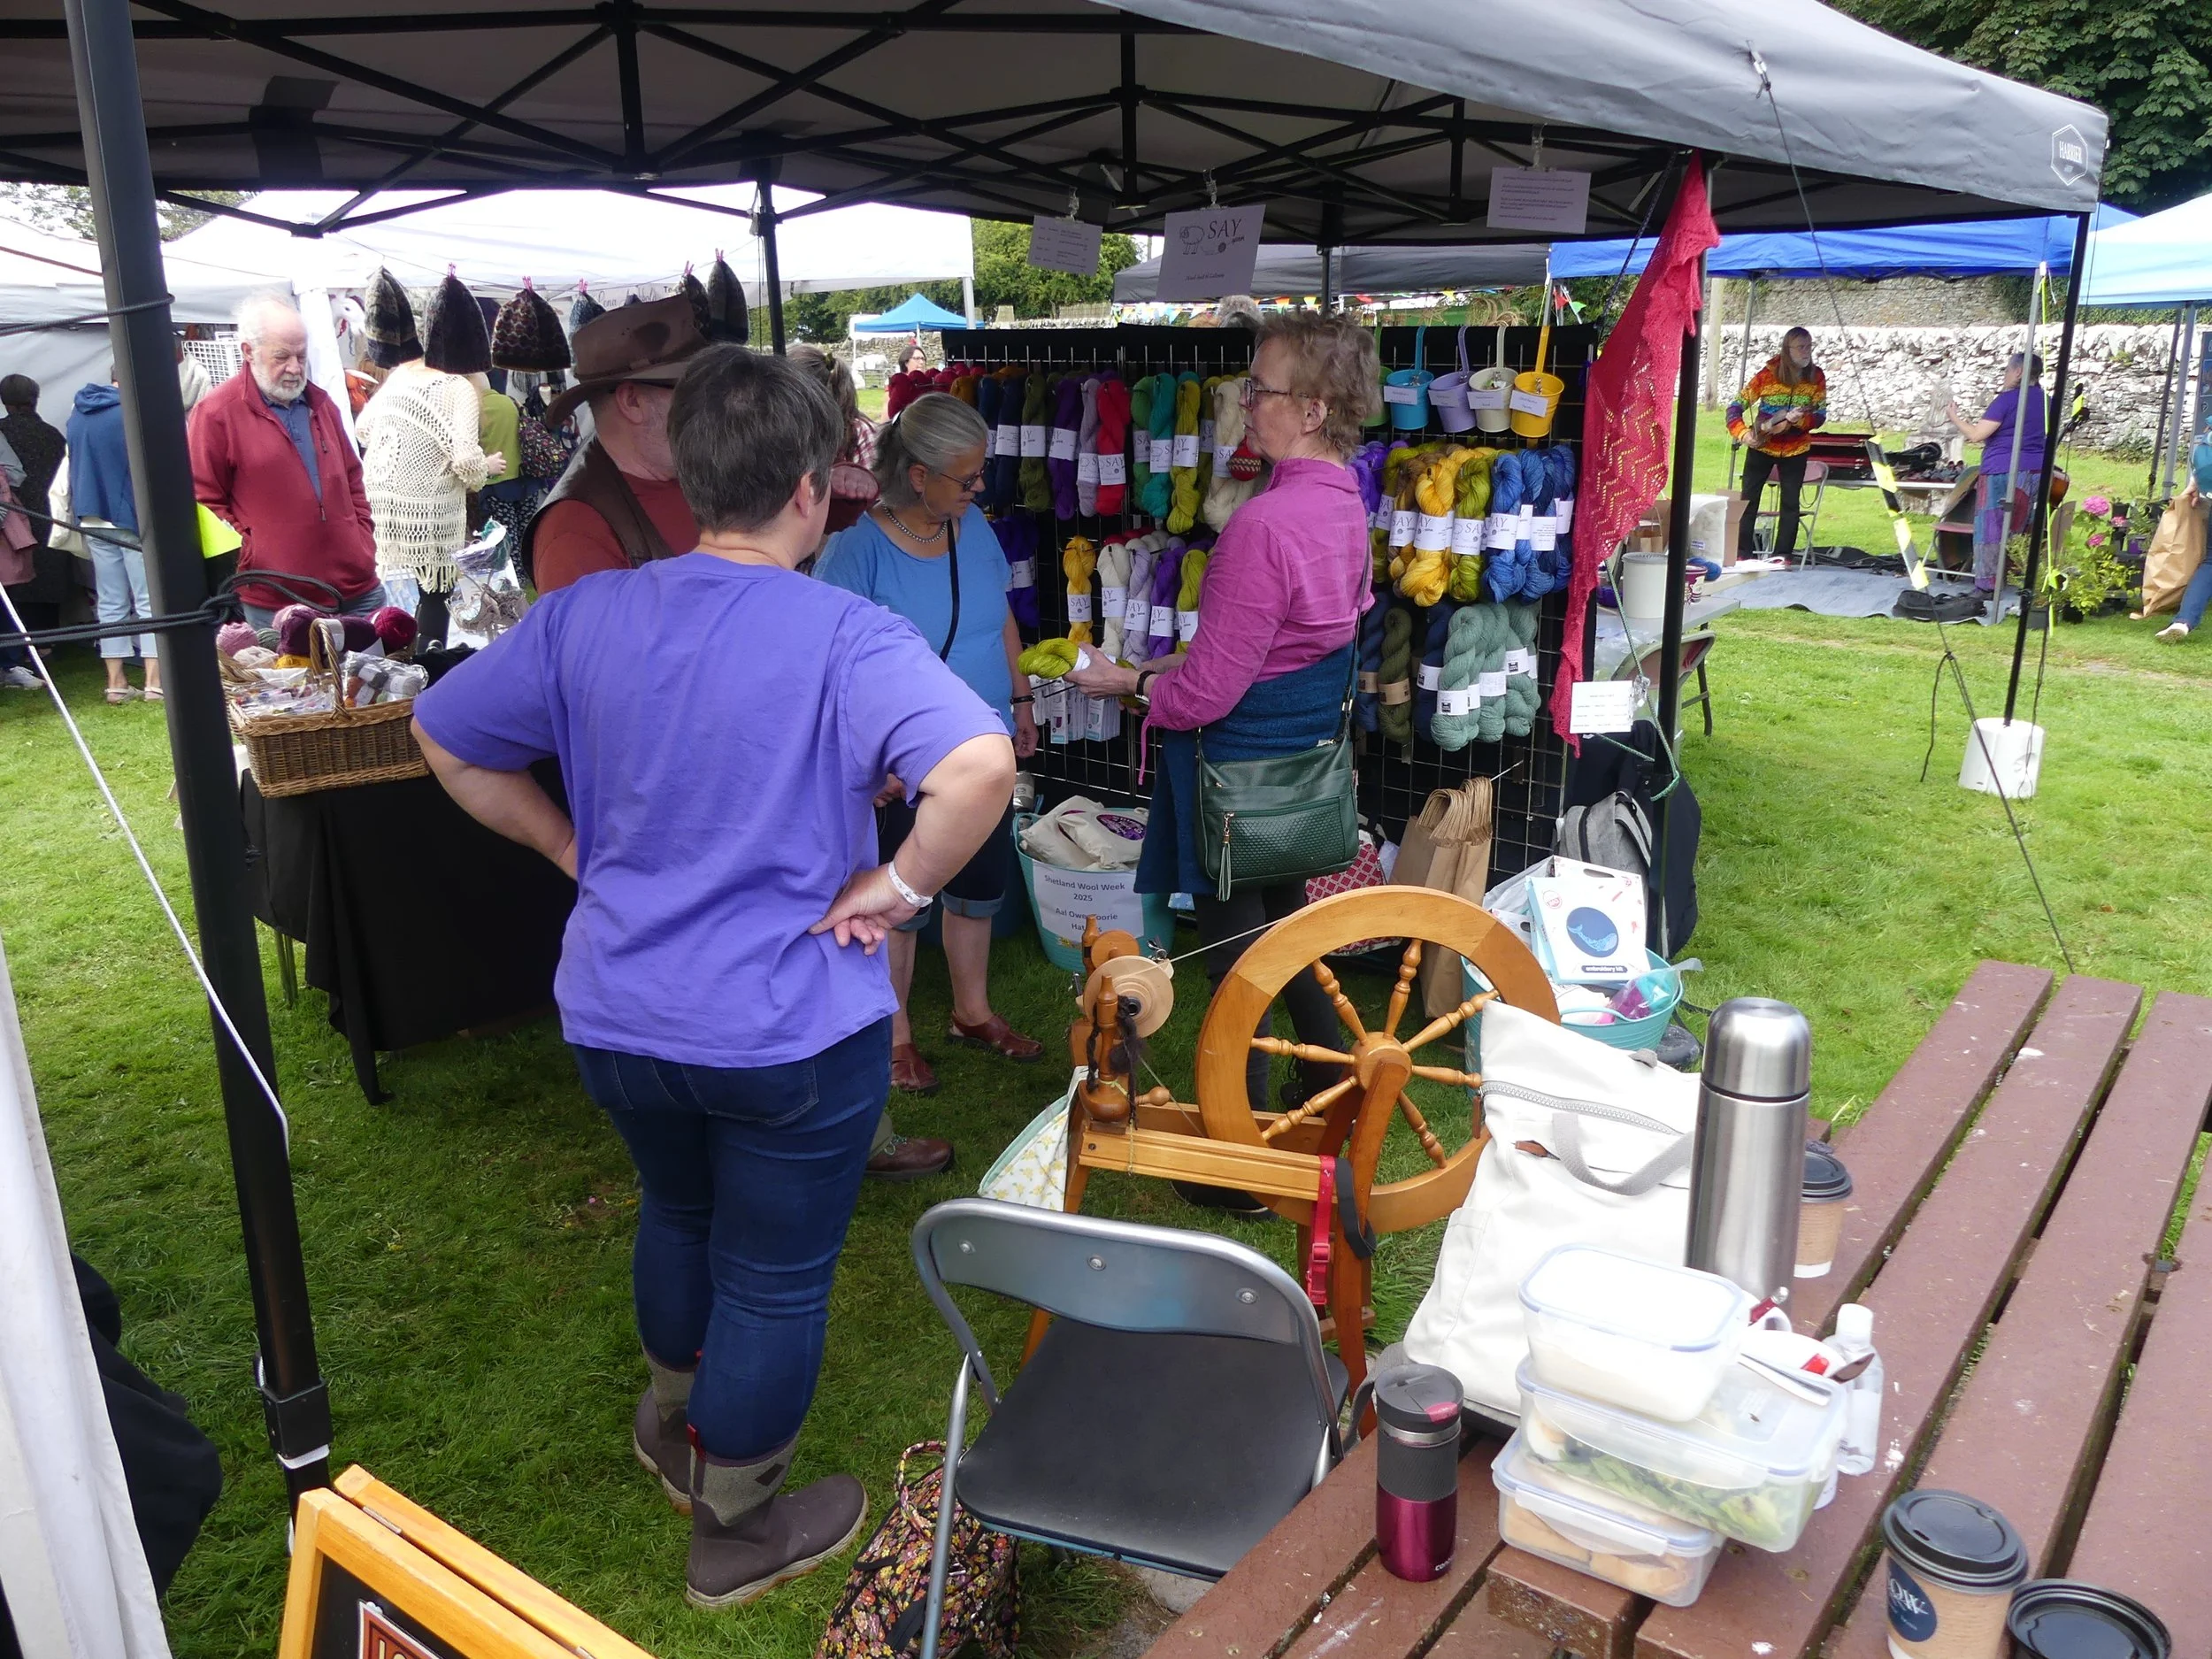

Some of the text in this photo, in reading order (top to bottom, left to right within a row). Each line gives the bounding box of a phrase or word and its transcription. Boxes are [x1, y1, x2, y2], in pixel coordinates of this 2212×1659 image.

[1208, 219, 1241, 239] SAY
[1137, 434, 1150, 446] SA
[1465, 522, 1482, 534] SA
[1071, 598, 1088, 607] SAY
[1045, 875, 1076, 887] Shetland
[1101, 882, 1125, 891] Week
[1073, 893, 1093, 902] 2025
[1069, 910, 1087, 919] Owe
